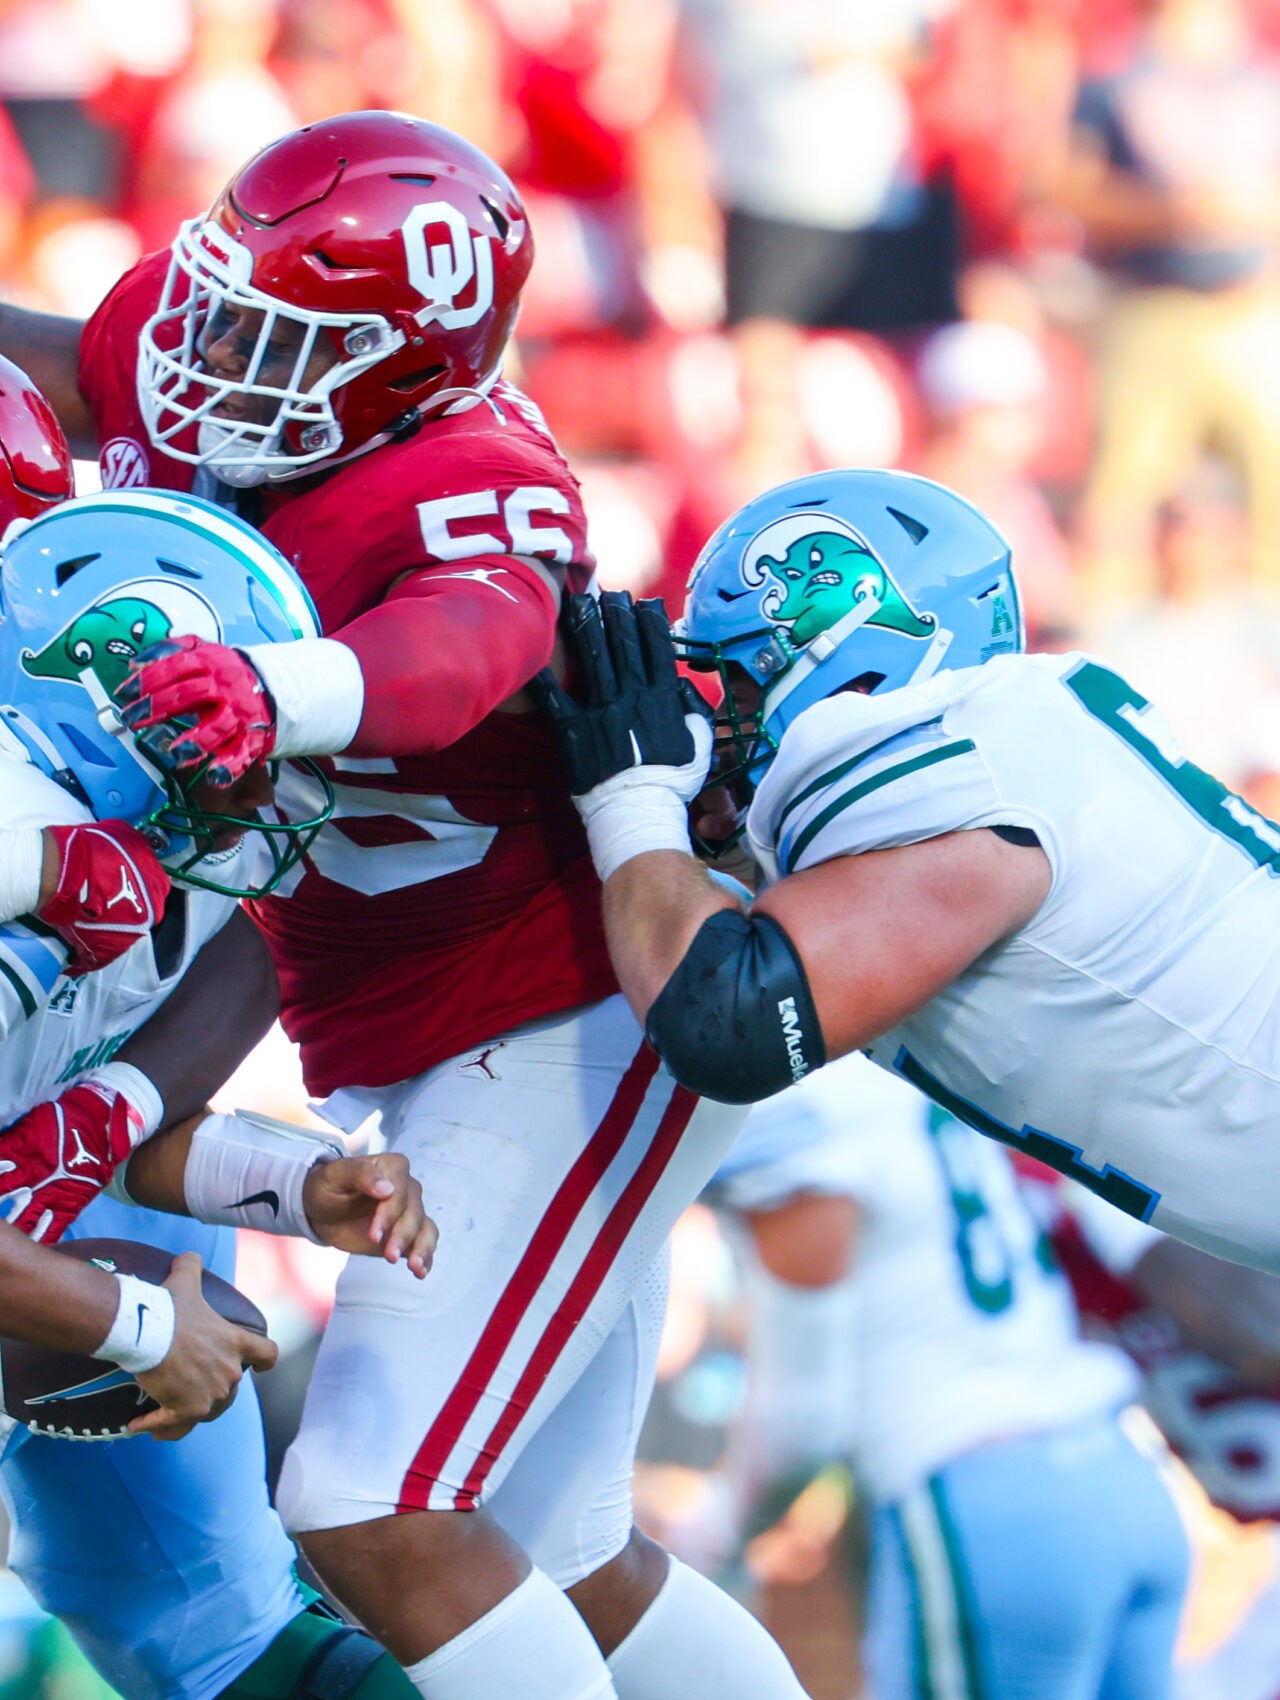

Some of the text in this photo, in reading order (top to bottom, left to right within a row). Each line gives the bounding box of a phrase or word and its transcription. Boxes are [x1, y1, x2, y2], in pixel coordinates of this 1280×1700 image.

[401, 201, 494, 330] OU
[415, 486, 574, 565] 56
[781, 1008, 809, 1082] Muelle
